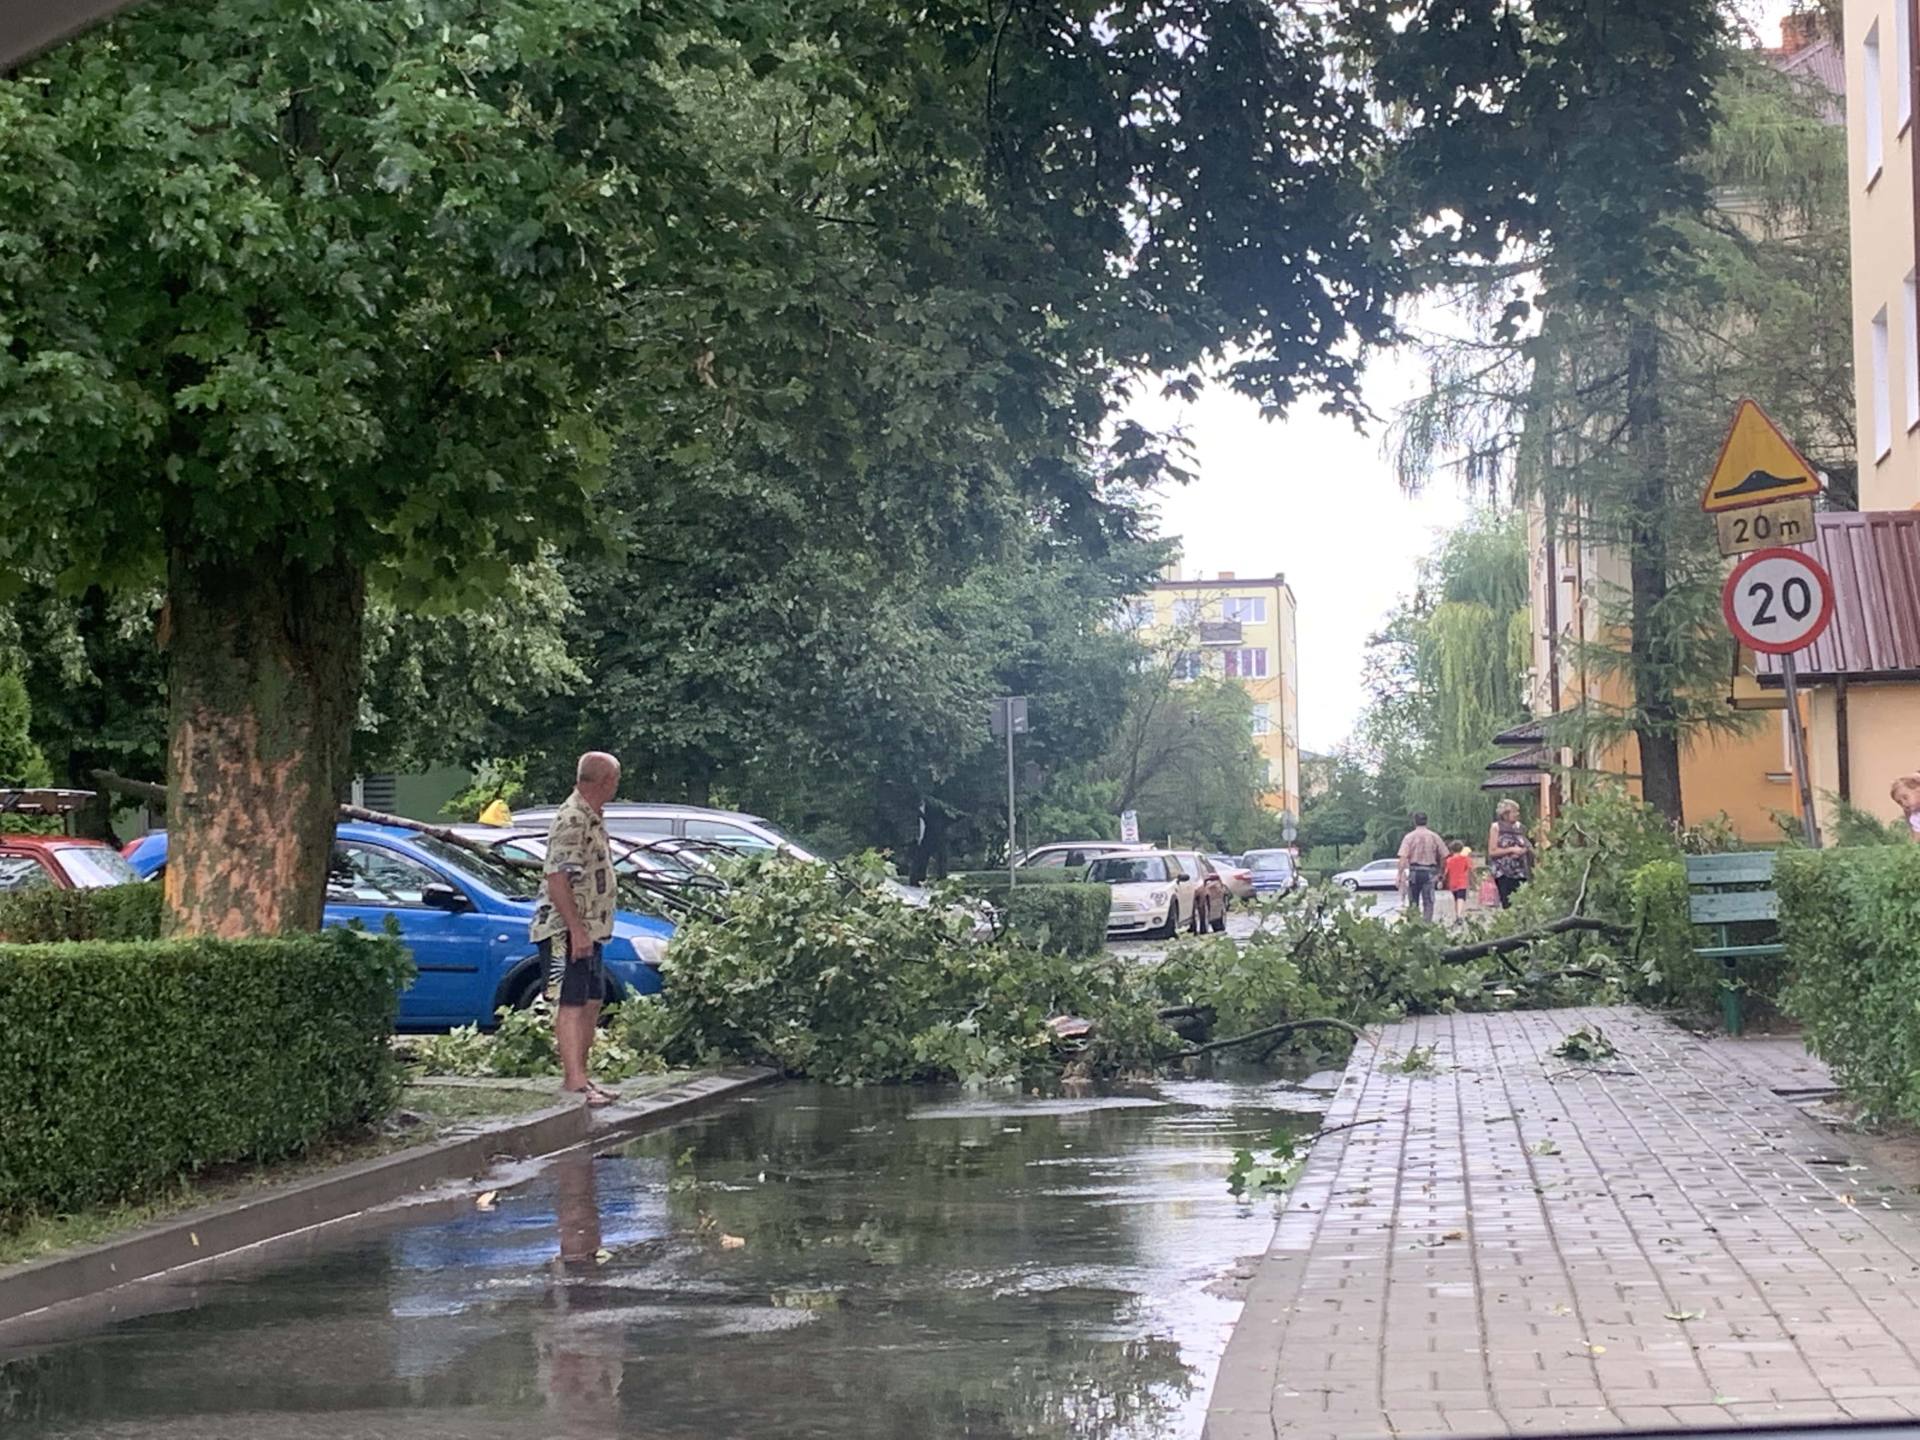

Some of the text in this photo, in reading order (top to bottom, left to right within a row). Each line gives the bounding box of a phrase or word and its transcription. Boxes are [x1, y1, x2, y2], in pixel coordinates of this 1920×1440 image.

[1733, 515, 1800, 543] 20 m
[1748, 577, 1811, 626] 20
